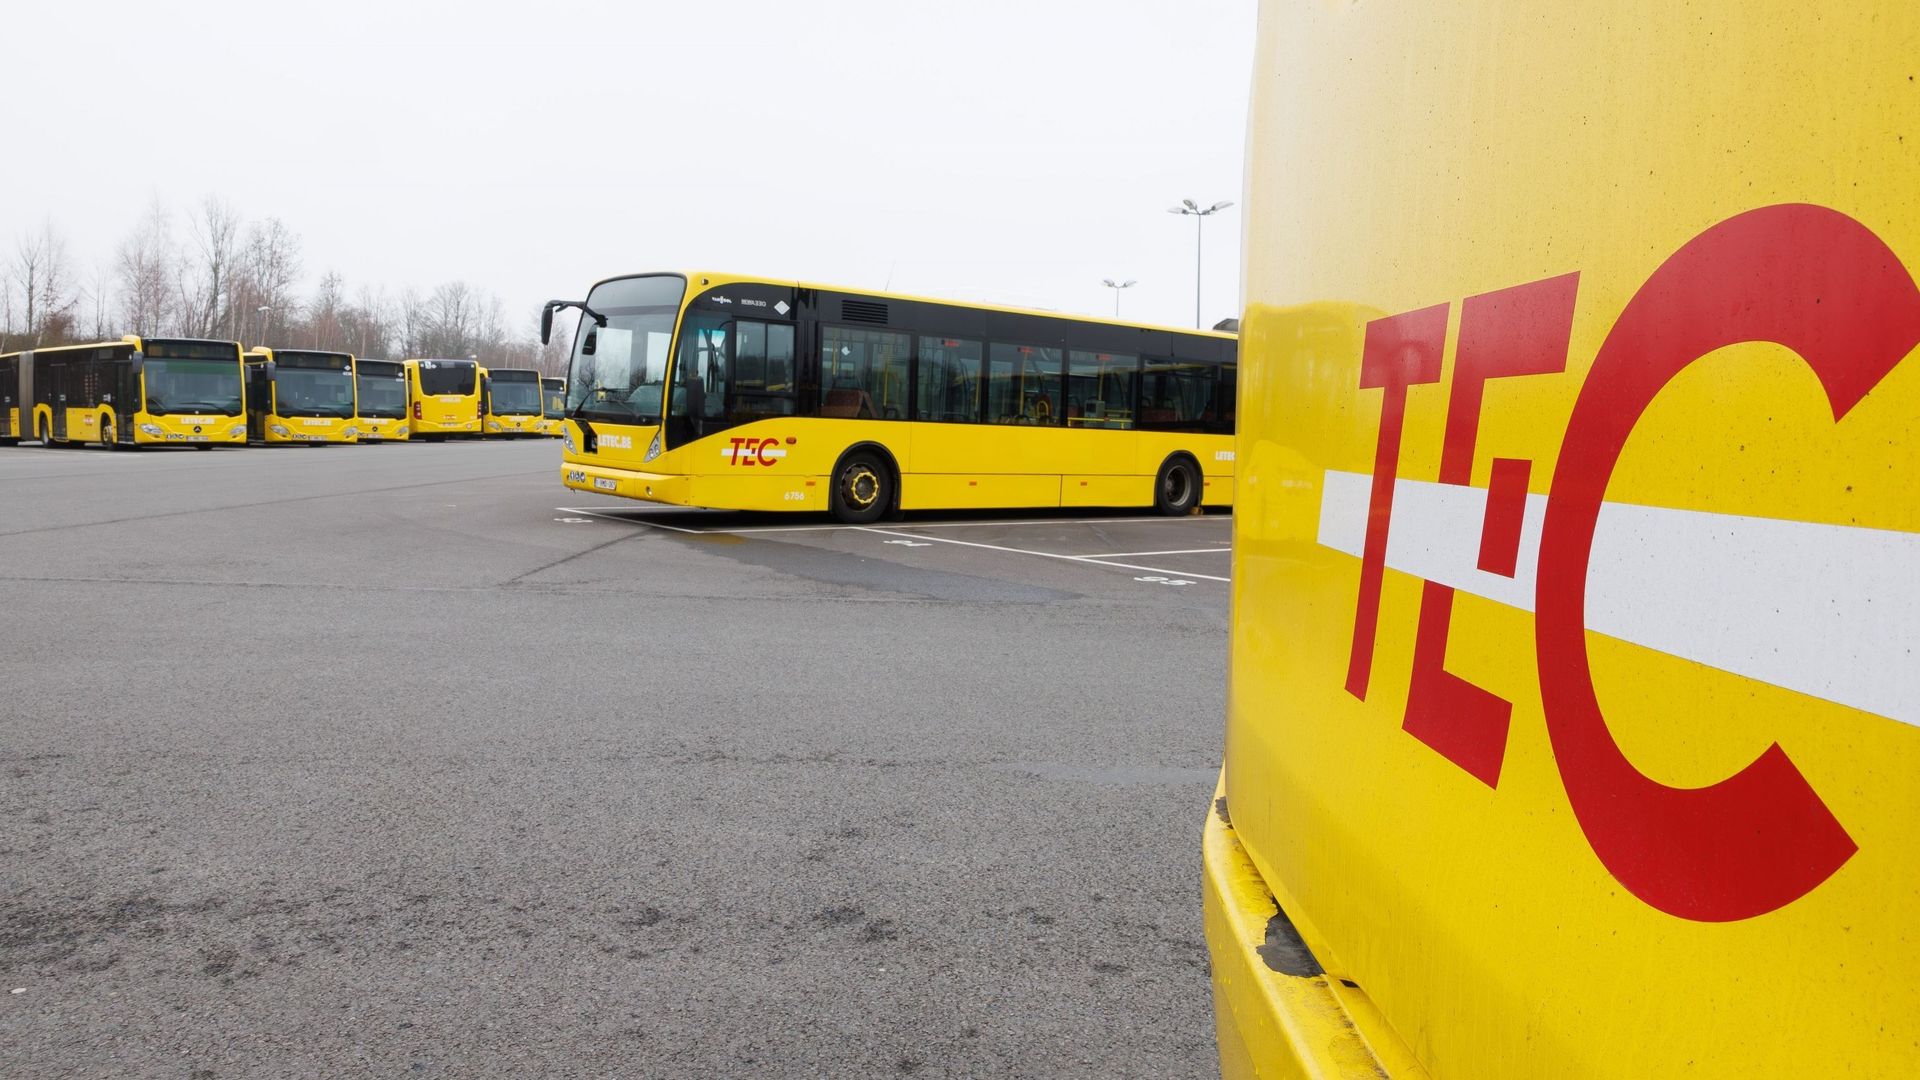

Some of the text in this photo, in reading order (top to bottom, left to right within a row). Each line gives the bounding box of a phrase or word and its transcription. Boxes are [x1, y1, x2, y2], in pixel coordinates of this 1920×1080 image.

[598, 434, 632, 449] LETEC.BE
[730, 437, 779, 467] TEC
[1345, 203, 1920, 923] TEC
